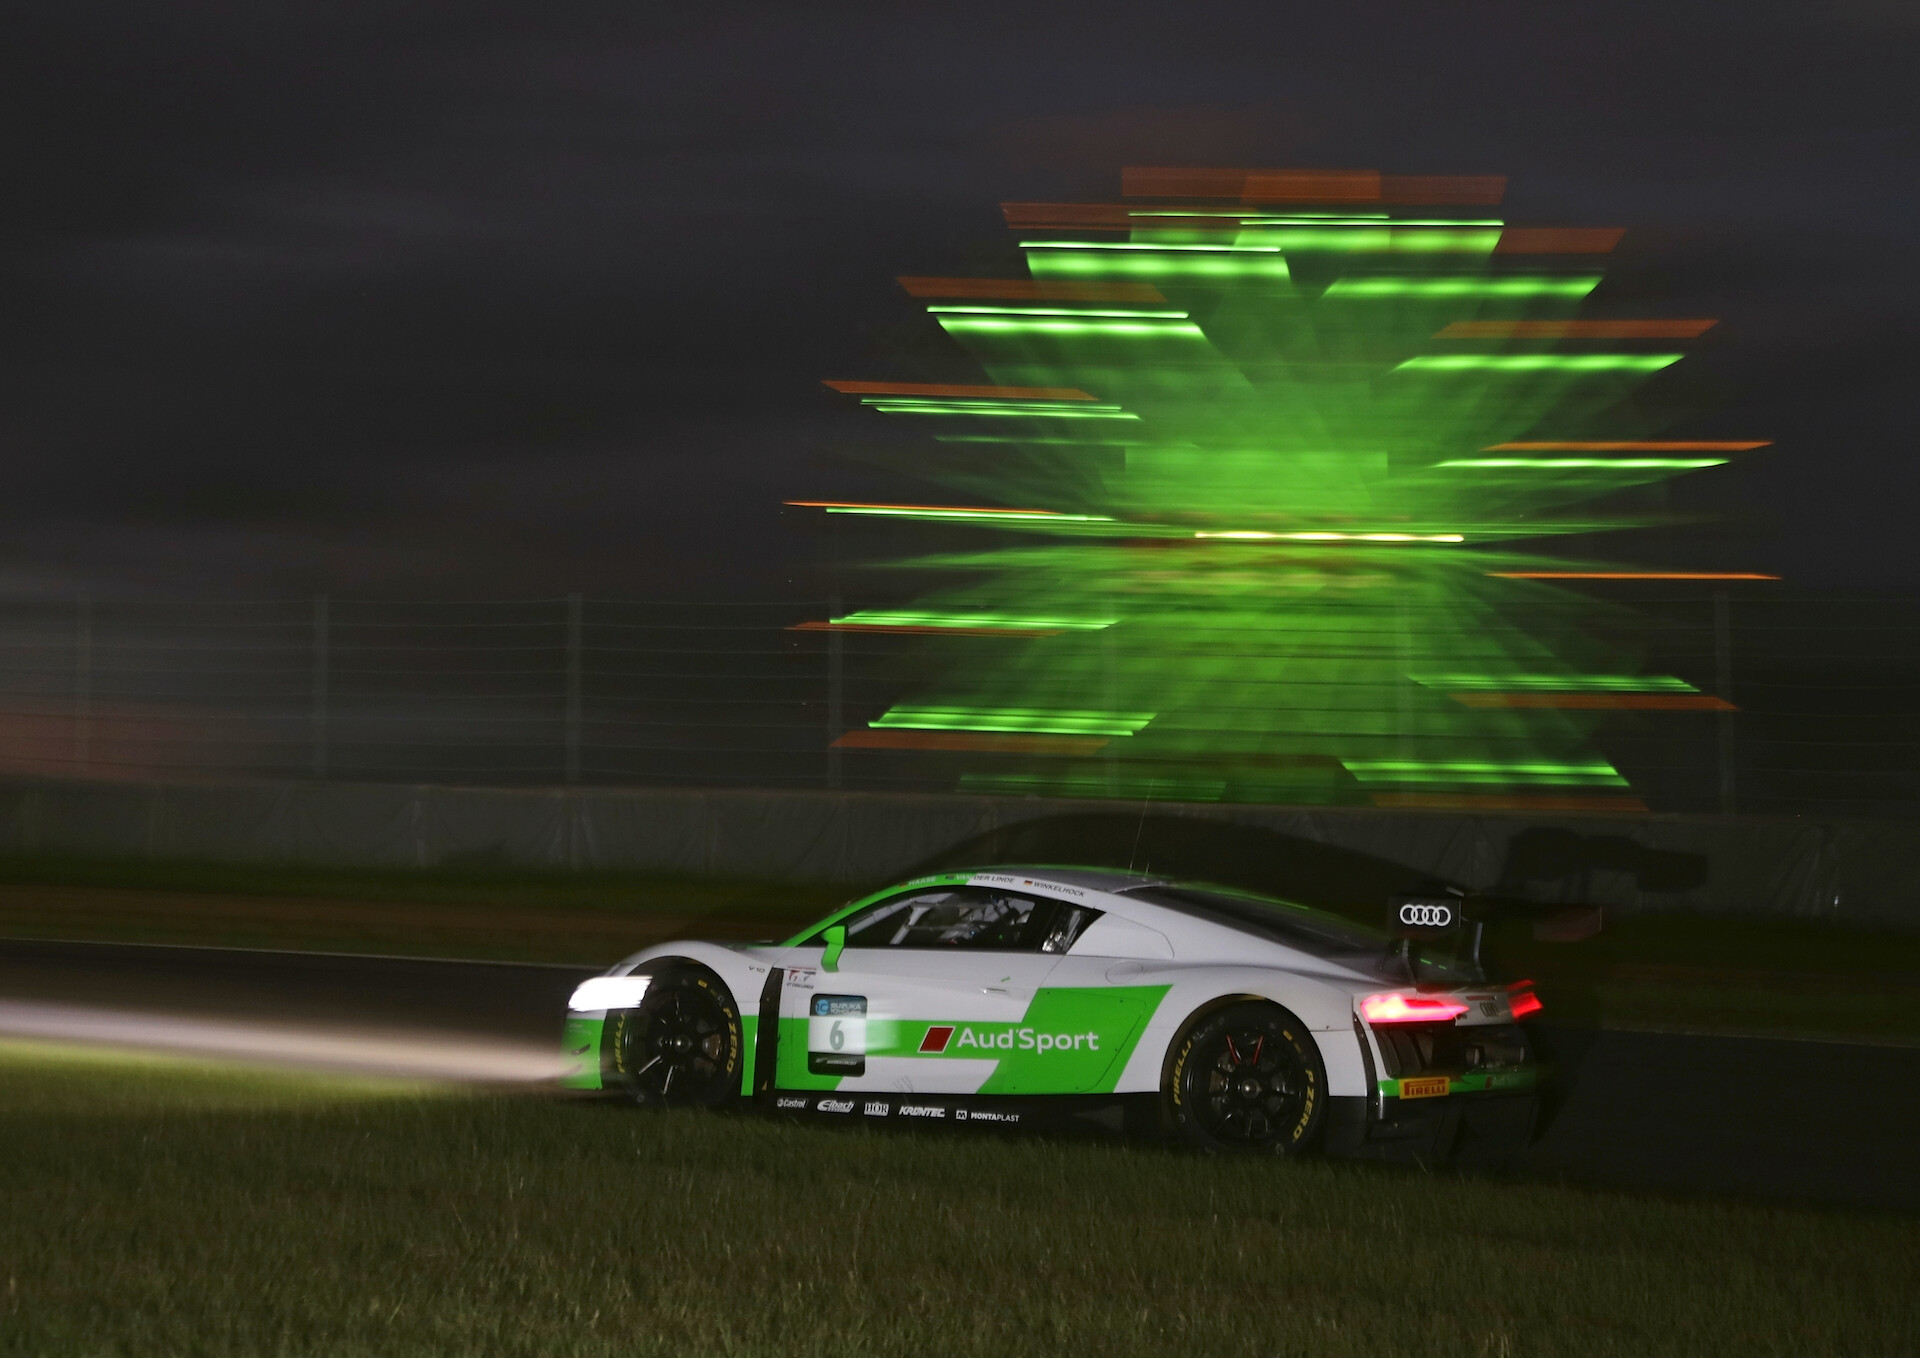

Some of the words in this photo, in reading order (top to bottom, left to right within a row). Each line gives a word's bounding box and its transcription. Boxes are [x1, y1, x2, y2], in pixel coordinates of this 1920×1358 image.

[908, 876, 937, 886] HAASE
[991, 876, 1015, 884] LINDE
[1033, 881, 1085, 897] WINKELHOCK
[829, 1020, 844, 1050] 6
[726, 1022, 738, 1073] ZERO
[1173, 1040, 1192, 1105] PIRELLI
[1403, 1078, 1446, 1096] PIRELLI
[784, 1099, 806, 1108] Castrol
[817, 1099, 855, 1113] Eibach
[970, 1112, 1020, 1122] MONTAPLAST
[1293, 1086, 1315, 1142] ZERO
